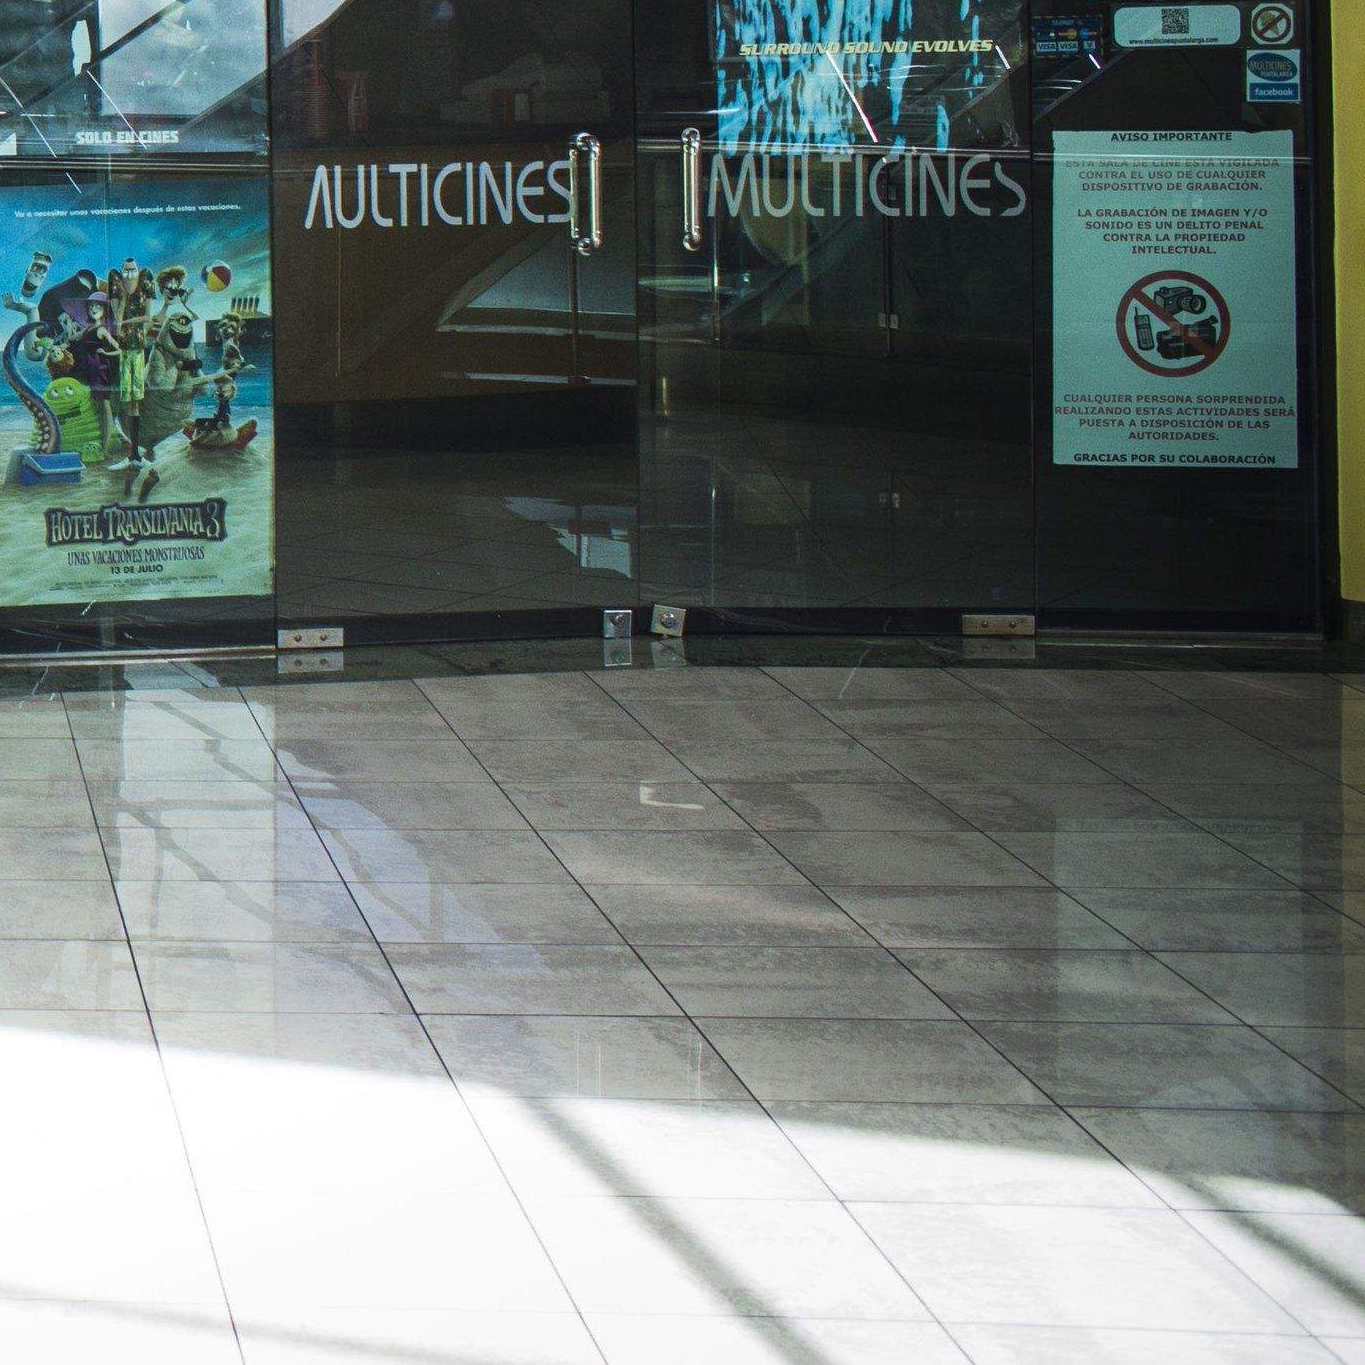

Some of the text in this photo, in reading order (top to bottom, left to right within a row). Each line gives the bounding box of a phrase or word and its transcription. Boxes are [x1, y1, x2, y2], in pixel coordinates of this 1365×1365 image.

[739, 39, 994, 55] SURROUND SOUND EVOLVES
[1038, 42, 1078, 50] VISA VISA
[1250, 61, 1292, 71] MULTICINES
[1254, 87, 1294, 97] facebook
[75, 131, 179, 145] SOLO EN CINES
[1111, 132, 1232, 142] AVISO IMPORTANTE
[1079, 170, 1266, 180] CONTRA EL USO DE CUALQUIER
[708, 153, 1027, 219] MULTICINES
[134, 205, 163, 214] después
[1085, 221, 1264, 230] SONIDO ES UN DELITO PENAL
[1103, 233, 1245, 242] CONTRA LA PROPIEDAD
[1074, 453, 1276, 464] GRACIAS POR SU COLABORACIÓN
[52, 502, 219, 543] HOTEL TRANSILVANIA 3
[68, 546, 204, 566] UNAS VACACIONES MONSTRUOSAS
[111, 564, 163, 575] 13 DE JULIO
